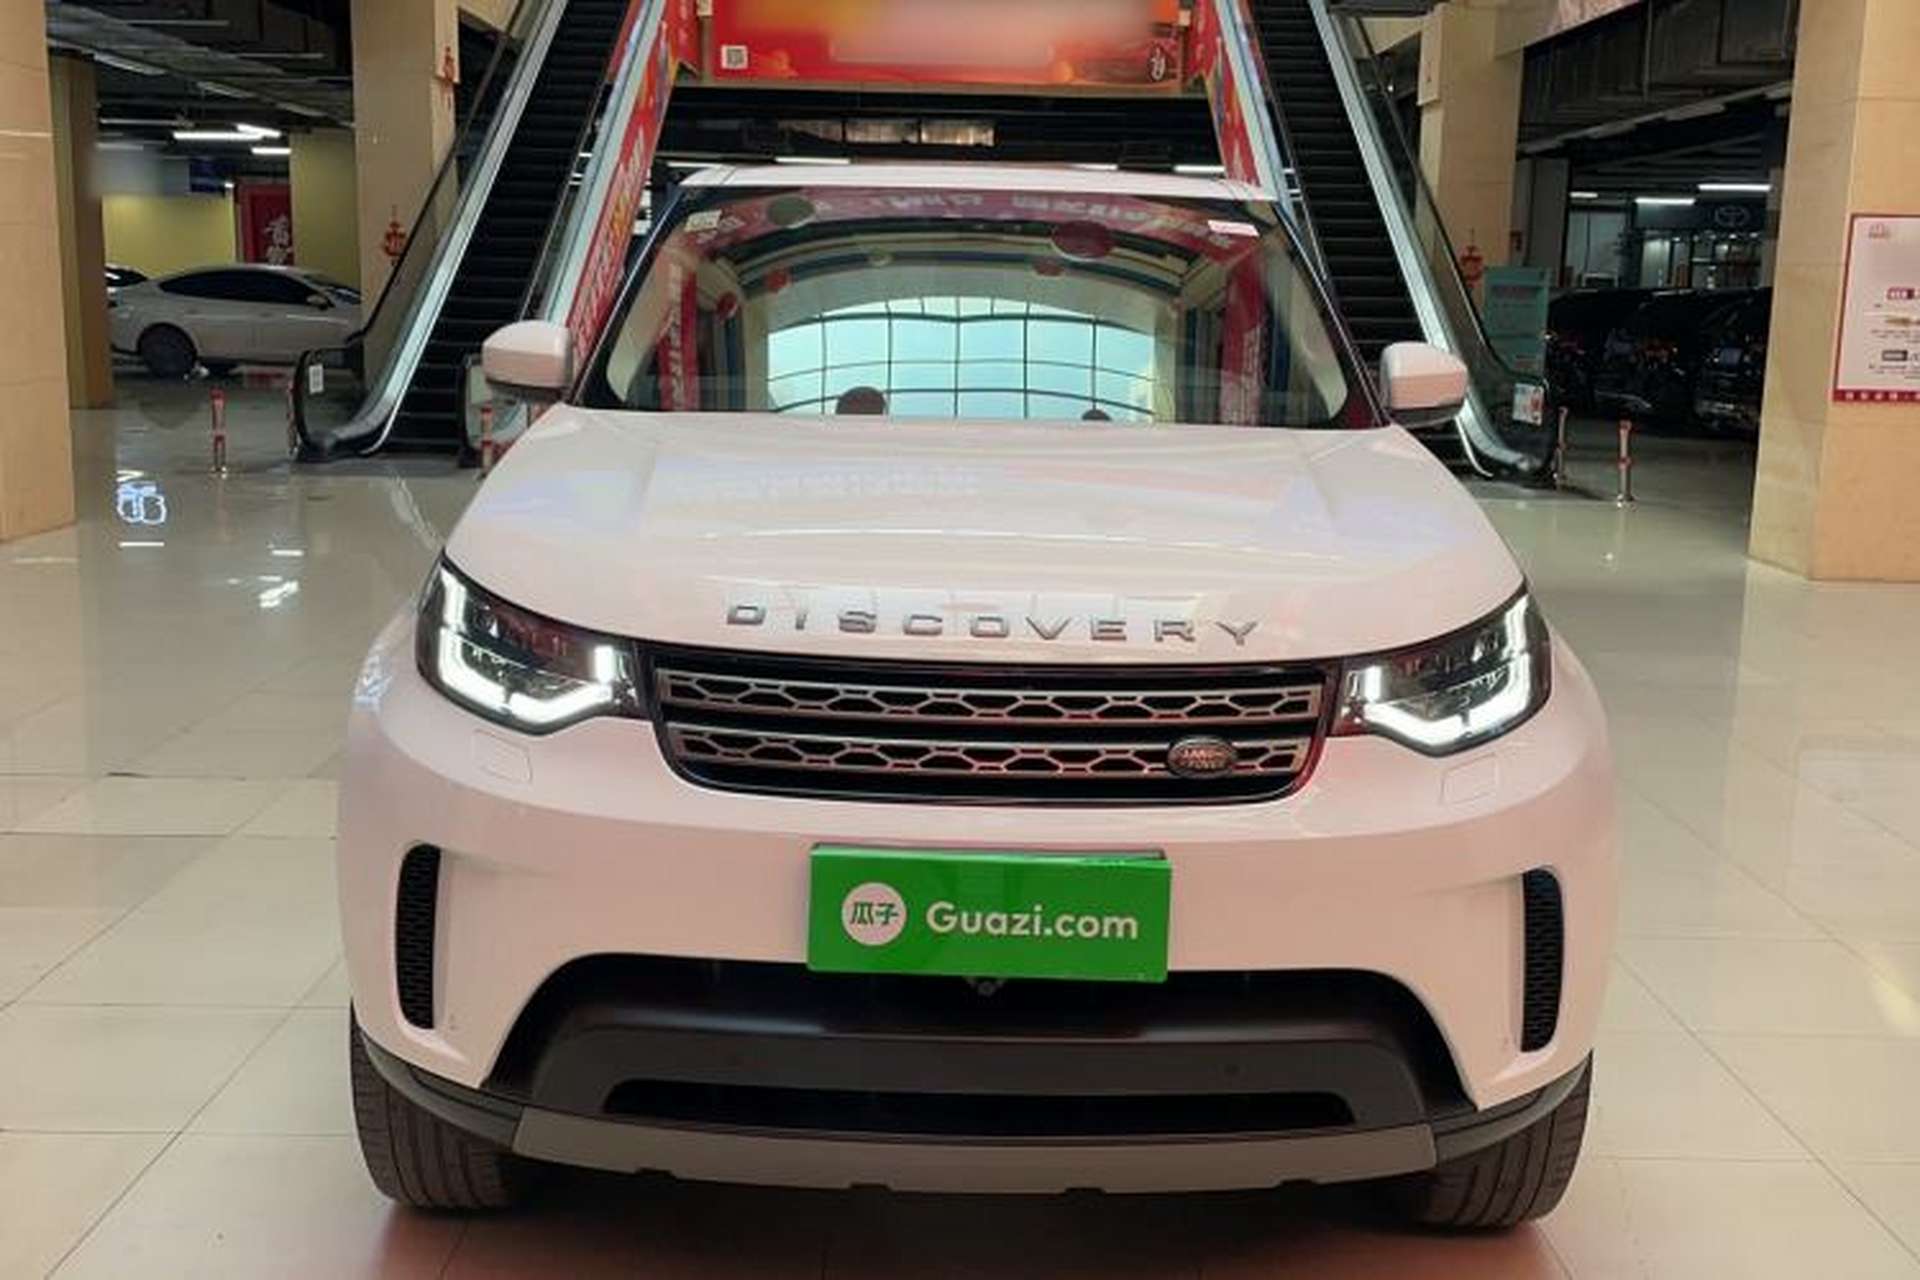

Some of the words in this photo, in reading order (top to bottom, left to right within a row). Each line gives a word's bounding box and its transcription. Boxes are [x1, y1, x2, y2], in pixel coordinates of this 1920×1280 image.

[727, 604, 1258, 646] DISCOVERY
[850, 901, 899, 926] 瓜子
[926, 901, 1139, 940] Guazi.com
